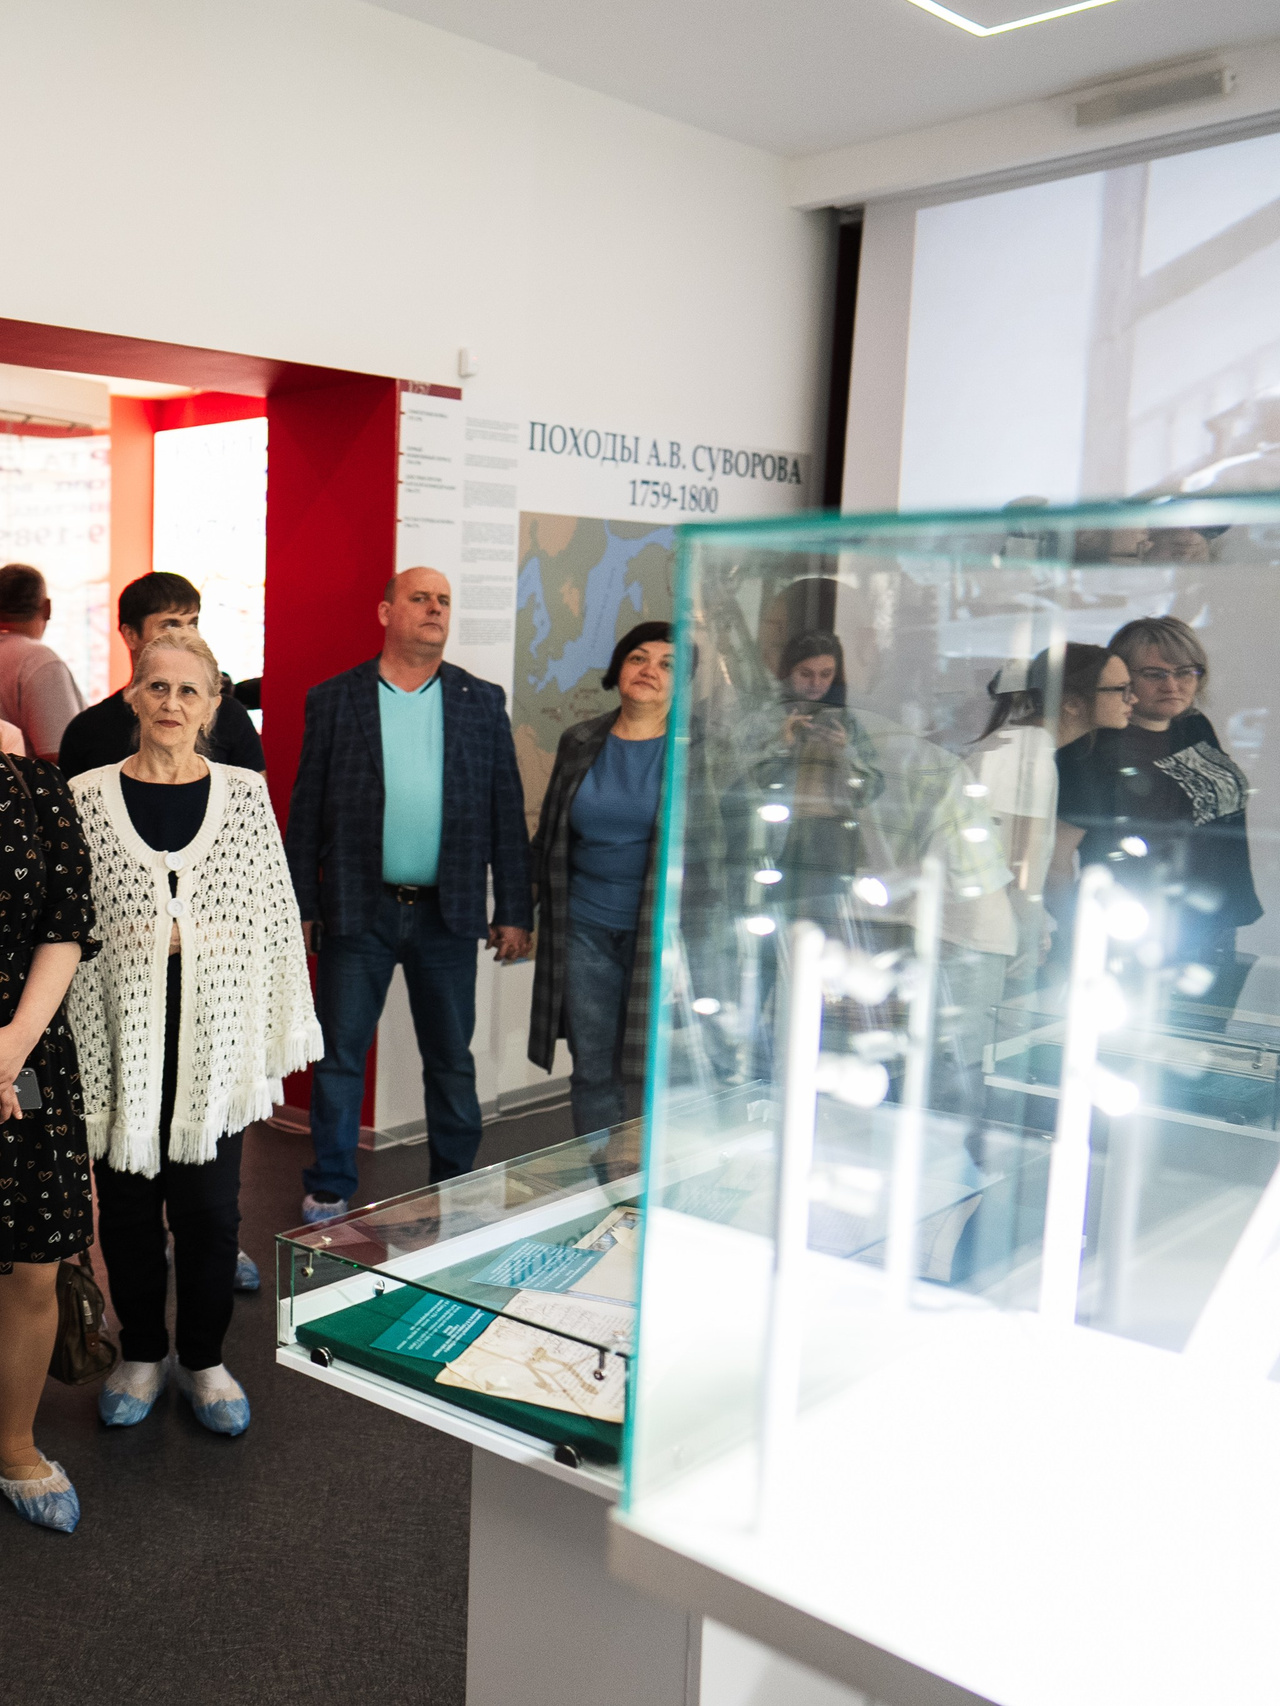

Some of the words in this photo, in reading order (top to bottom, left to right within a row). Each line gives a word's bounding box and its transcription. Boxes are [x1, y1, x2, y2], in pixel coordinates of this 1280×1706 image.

[529, 421, 640, 468] ПОХОДЫ
[646, 439, 687, 470] А.В.
[693, 444, 802, 485] СУВОРОВА
[629, 479, 719, 514] 1759-1800
